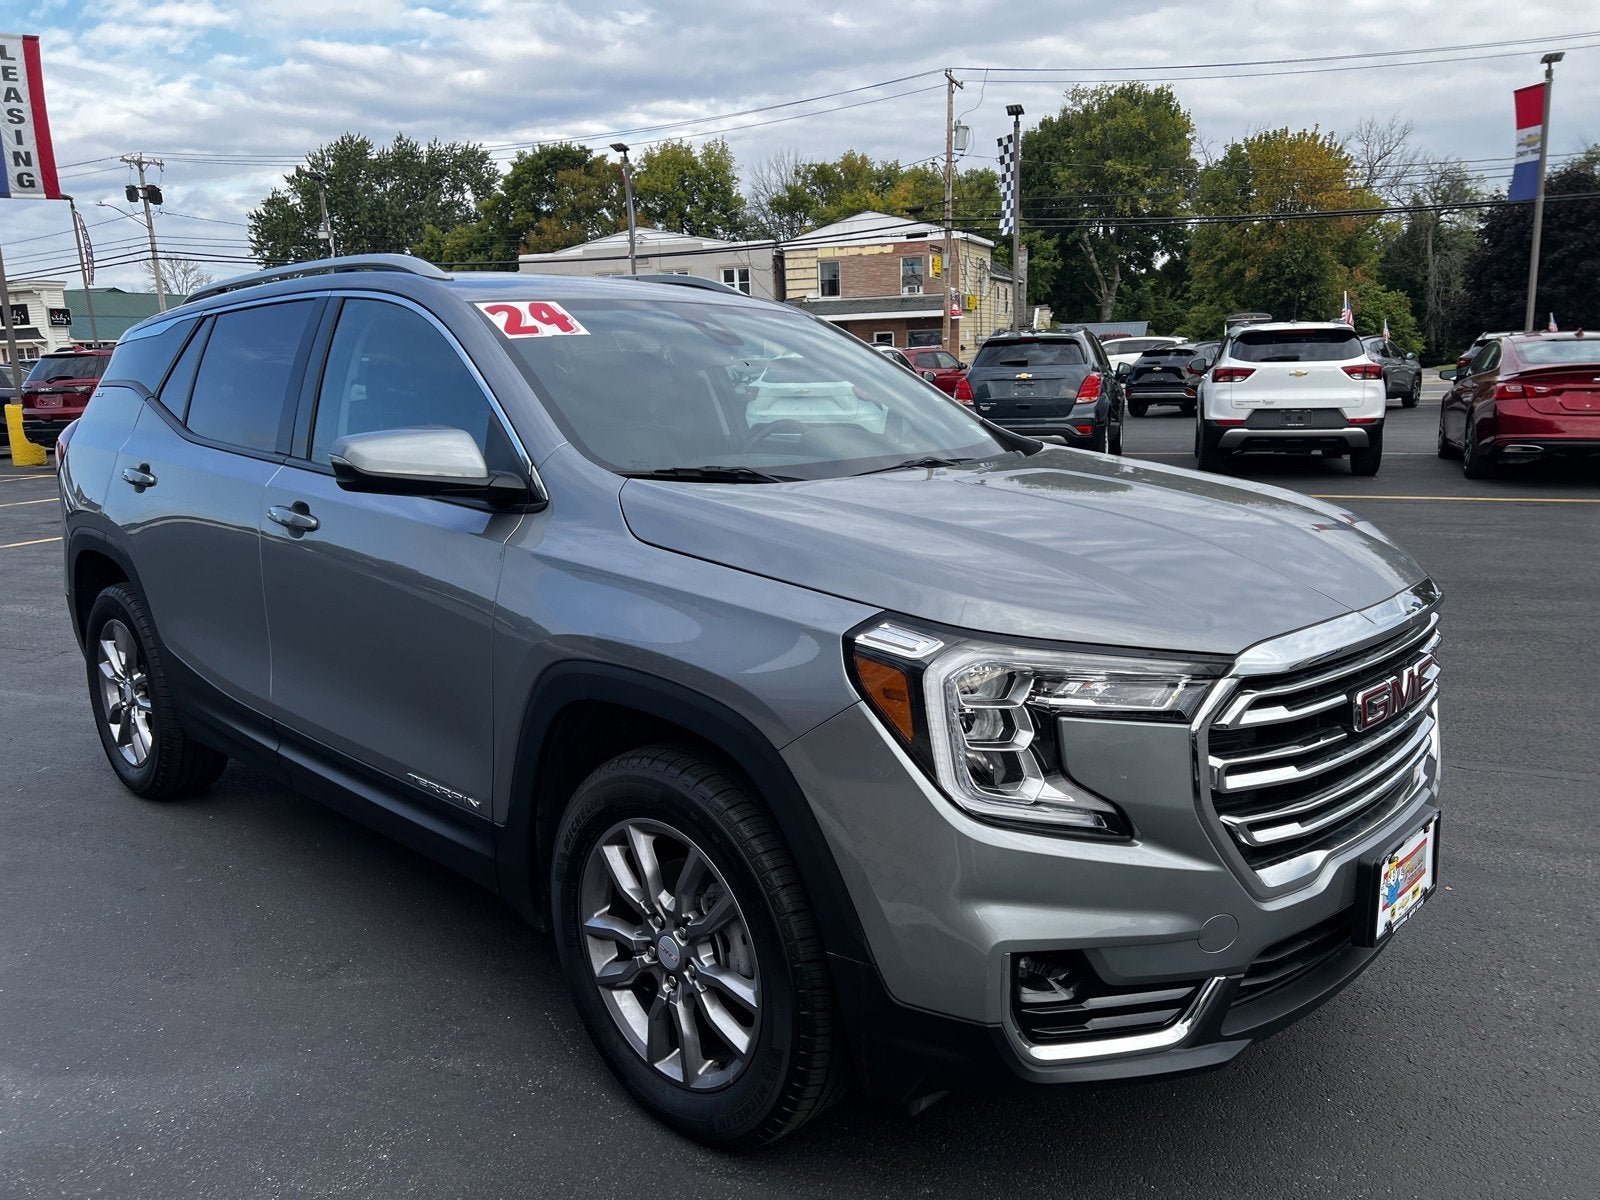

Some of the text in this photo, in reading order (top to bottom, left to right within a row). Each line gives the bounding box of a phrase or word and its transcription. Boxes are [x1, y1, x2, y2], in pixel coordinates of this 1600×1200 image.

[0, 44, 36, 188] LEASING
[484, 302, 577, 336] 24
[1353, 653, 1440, 733] GMC
[406, 772, 481, 808] TERRAIN
